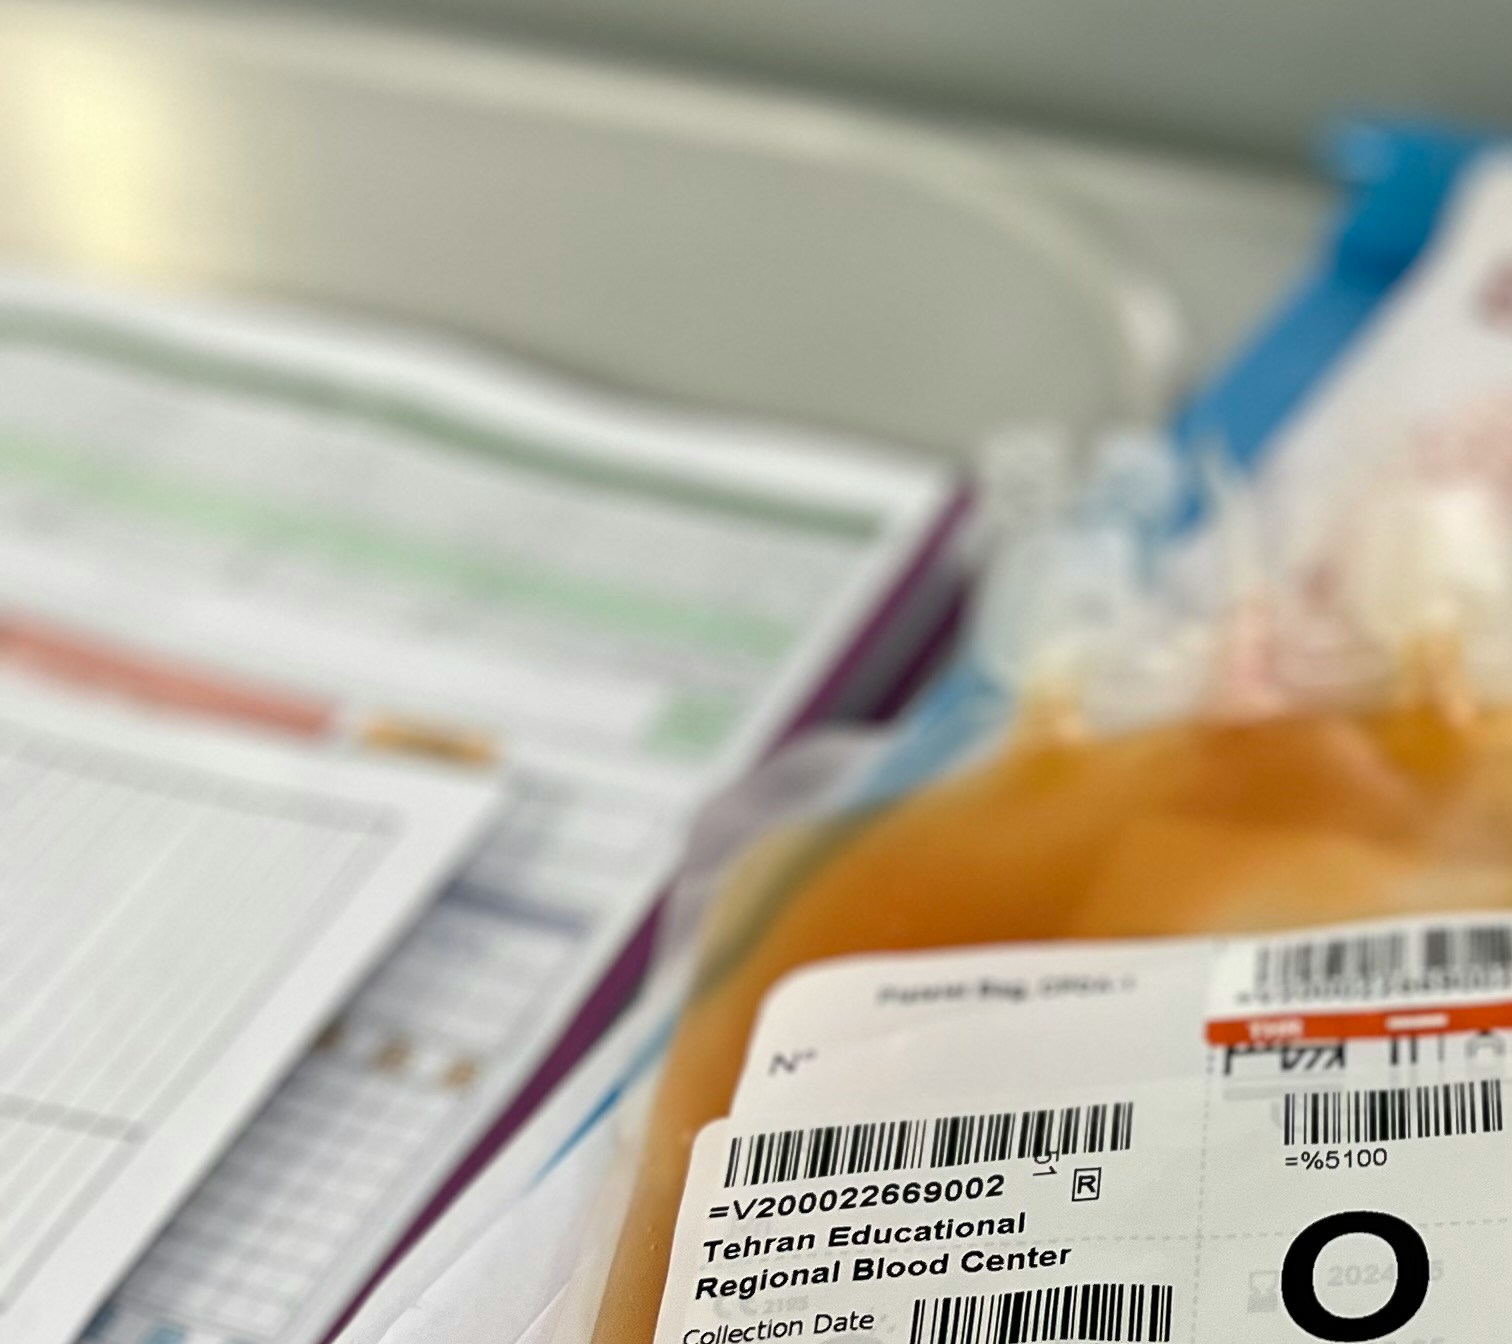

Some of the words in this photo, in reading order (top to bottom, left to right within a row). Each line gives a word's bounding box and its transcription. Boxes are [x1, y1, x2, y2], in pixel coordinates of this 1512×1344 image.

[1285, 1147, 1388, 1171] =%5100
[708, 1174, 1006, 1222] =V200022669002
[704, 1231, 816, 1264] Tehran
[828, 1211, 1027, 1248] Educational
[695, 1260, 841, 1301] Regional
[852, 1253, 949, 1281] Blood
[961, 1245, 1072, 1274] Center
[1281, 1209, 1431, 1344] O
[814, 1310, 876, 1337] Date
